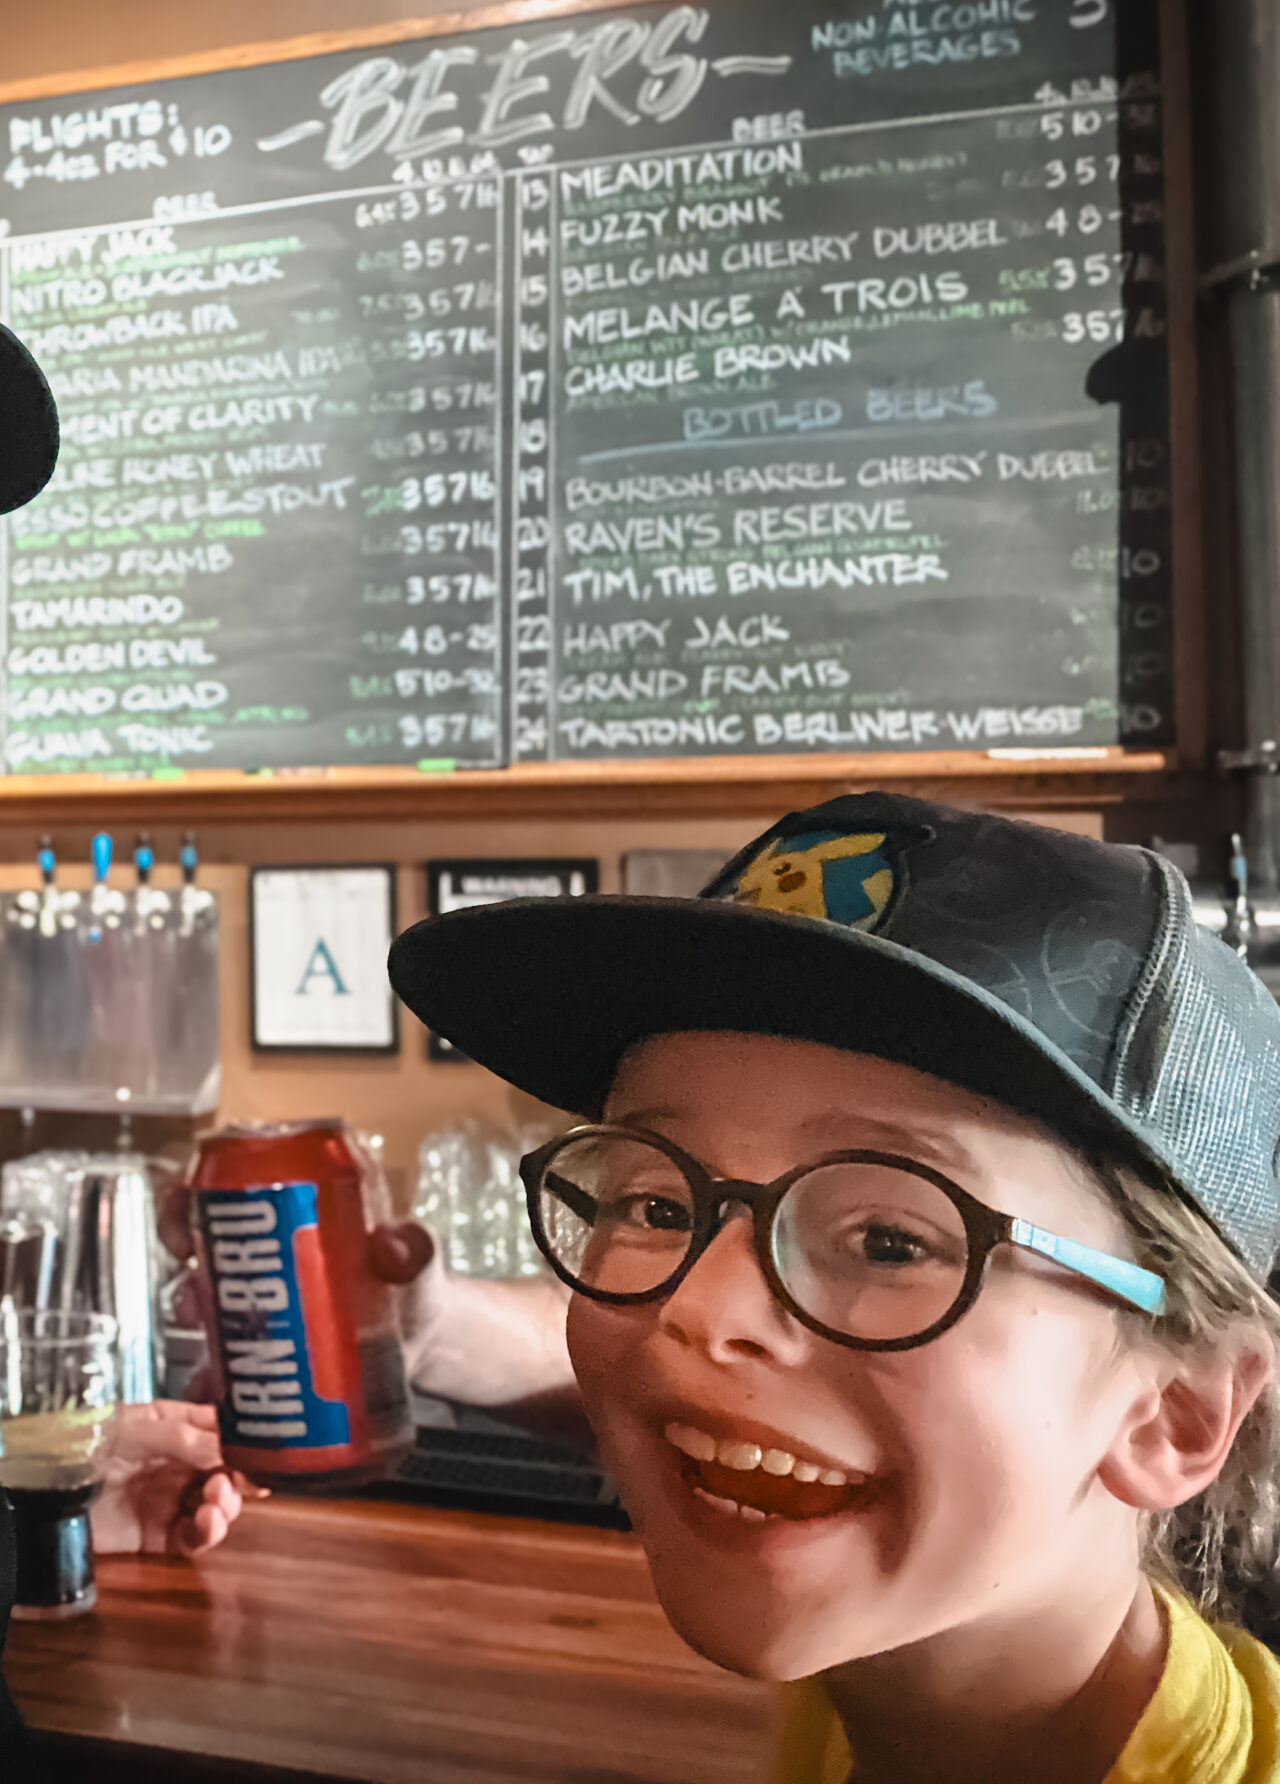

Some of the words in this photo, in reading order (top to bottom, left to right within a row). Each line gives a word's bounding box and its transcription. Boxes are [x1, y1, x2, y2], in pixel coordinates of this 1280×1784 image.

[560, 141, 803, 200] MEADITATION
[560, 208, 669, 249] FUZZY
[676, 197, 783, 234] MONK
[561, 250, 709, 298] BELGIAN
[721, 232, 860, 271] CHERRY
[874, 219, 1010, 259] DUBBEL
[562, 294, 753, 350] MELANGE
[821, 273, 970, 312] TROIS
[564, 347, 700, 397] CHARLIE
[715, 338, 852, 373] BROWN
[188, 396, 321, 433] CLARITY
[683, 401, 842, 442] BOTTLED
[866, 380, 998, 421] BEERS
[856, 451, 986, 485] CHERRY
[564, 509, 719, 556] RAVEN'S
[733, 500, 913, 544] RESERVE
[517, 568, 547, 601] 21
[655, 563, 720, 597] THE
[727, 555, 950, 595] ENCHANTER
[563, 619, 672, 656] HAPPY
[684, 613, 791, 648] JACK
[558, 666, 688, 704] GRAND
[700, 659, 852, 695] FRAMB
[294, 935, 350, 996] A
